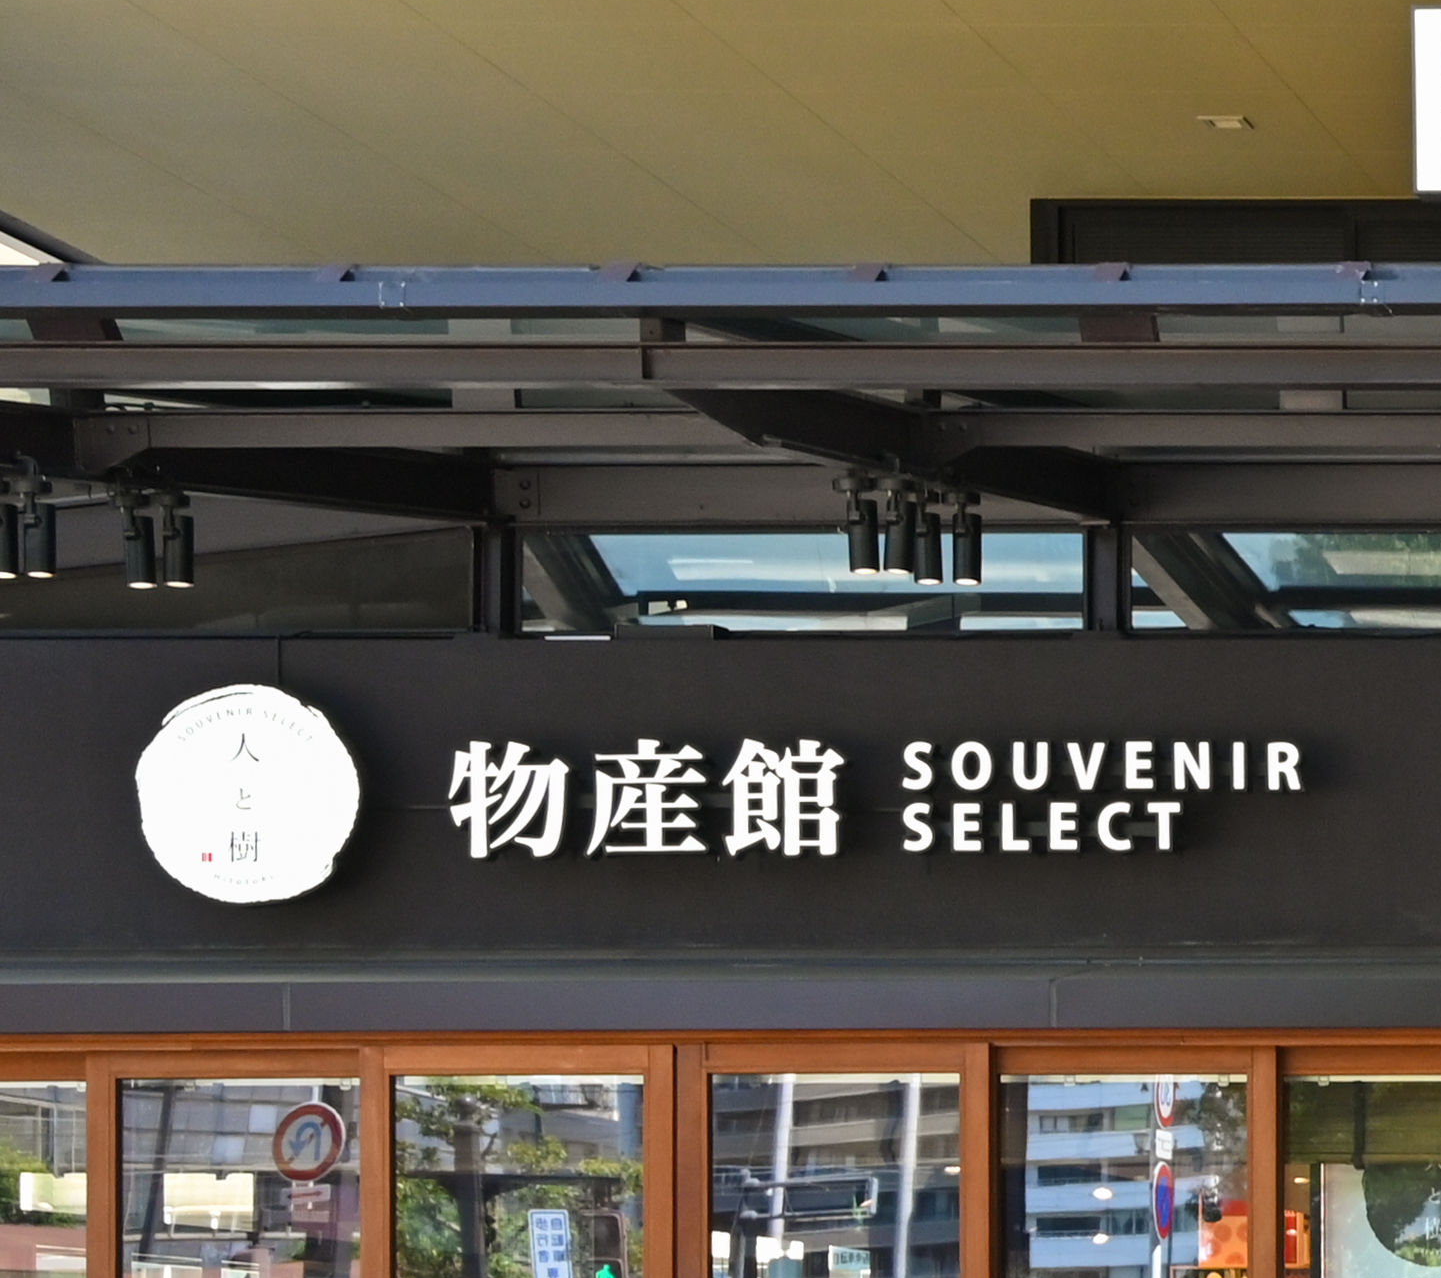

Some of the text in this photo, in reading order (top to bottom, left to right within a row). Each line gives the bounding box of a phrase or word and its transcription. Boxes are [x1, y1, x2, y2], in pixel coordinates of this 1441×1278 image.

[228, 733, 261, 862] 人と樹
[448, 738, 846, 859] 物産館
[902, 741, 1302, 791] SOUVENIR
[902, 801, 1182, 852] SELECT
